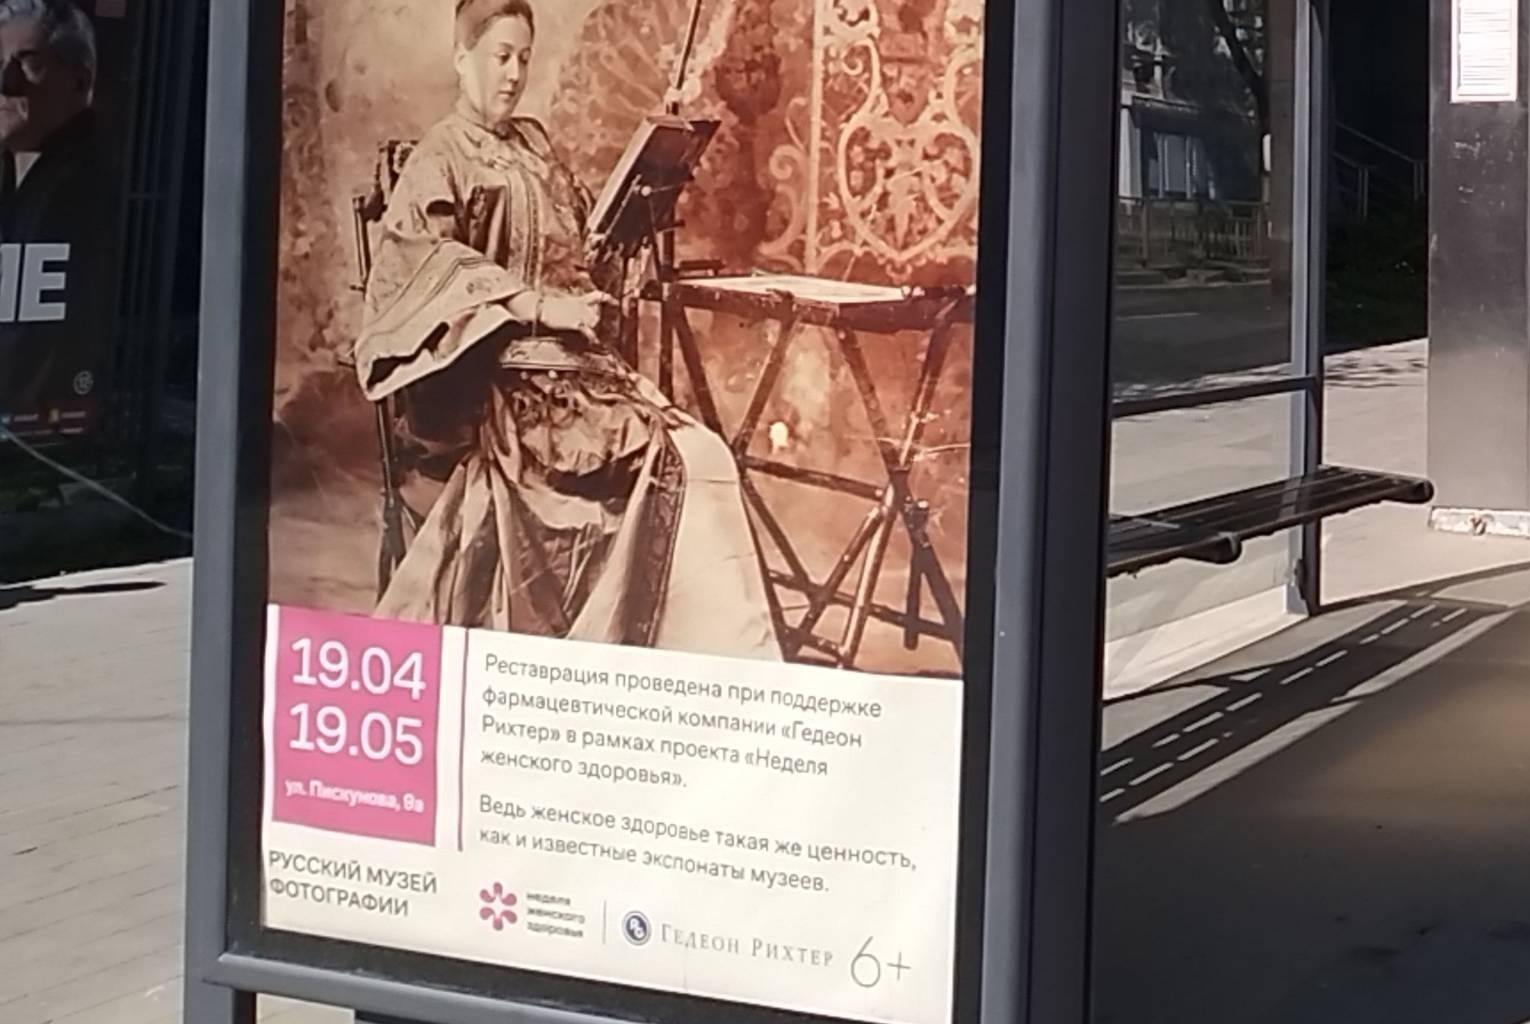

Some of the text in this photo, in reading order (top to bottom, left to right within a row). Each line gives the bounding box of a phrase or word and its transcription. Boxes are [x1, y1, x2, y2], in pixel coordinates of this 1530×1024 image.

[292, 638, 426, 699] 19.04
[484, 653, 883, 718] Реставрация проведена при поддержке
[289, 703, 423, 764] 19.05
[481, 686, 863, 748] фармацевтической компании «Гедеон
[481, 714, 828, 776] Рихтер» в рамках проекта «Неделя
[480, 751, 687, 787] женского здоровья».
[479, 794, 917, 871] Ведь женское здоровье такая же ценность,
[479, 829, 830, 891] как и известные экспонаты музеев.
[268, 850, 438, 893] РУССКИЙ МУЗЕЙ
[269, 877, 409, 916] ФОТОГРАФИИ
[850, 936, 912, 988] 6+
